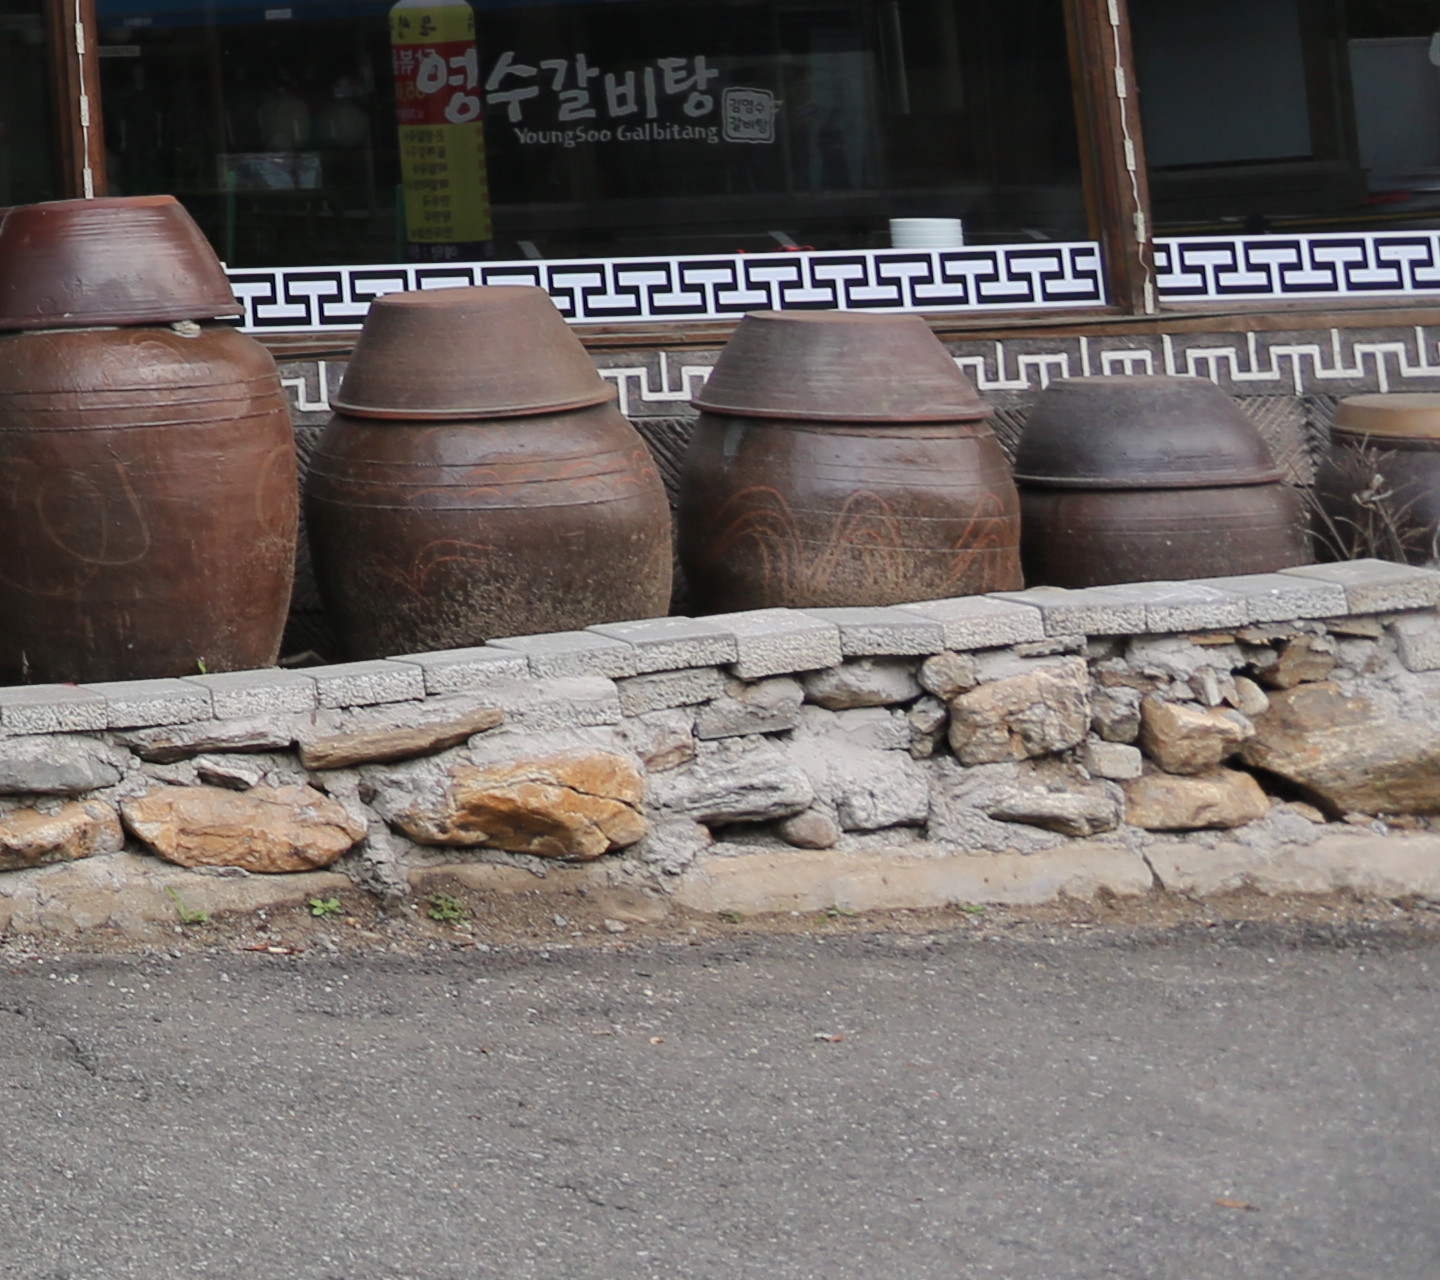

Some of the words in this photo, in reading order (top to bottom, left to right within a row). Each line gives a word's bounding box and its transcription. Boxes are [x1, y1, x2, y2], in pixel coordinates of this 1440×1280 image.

[416, 48, 720, 124] 영수갈비탕
[514, 126, 612, 148] YoungSoo
[617, 123, 719, 144] Galbitang
